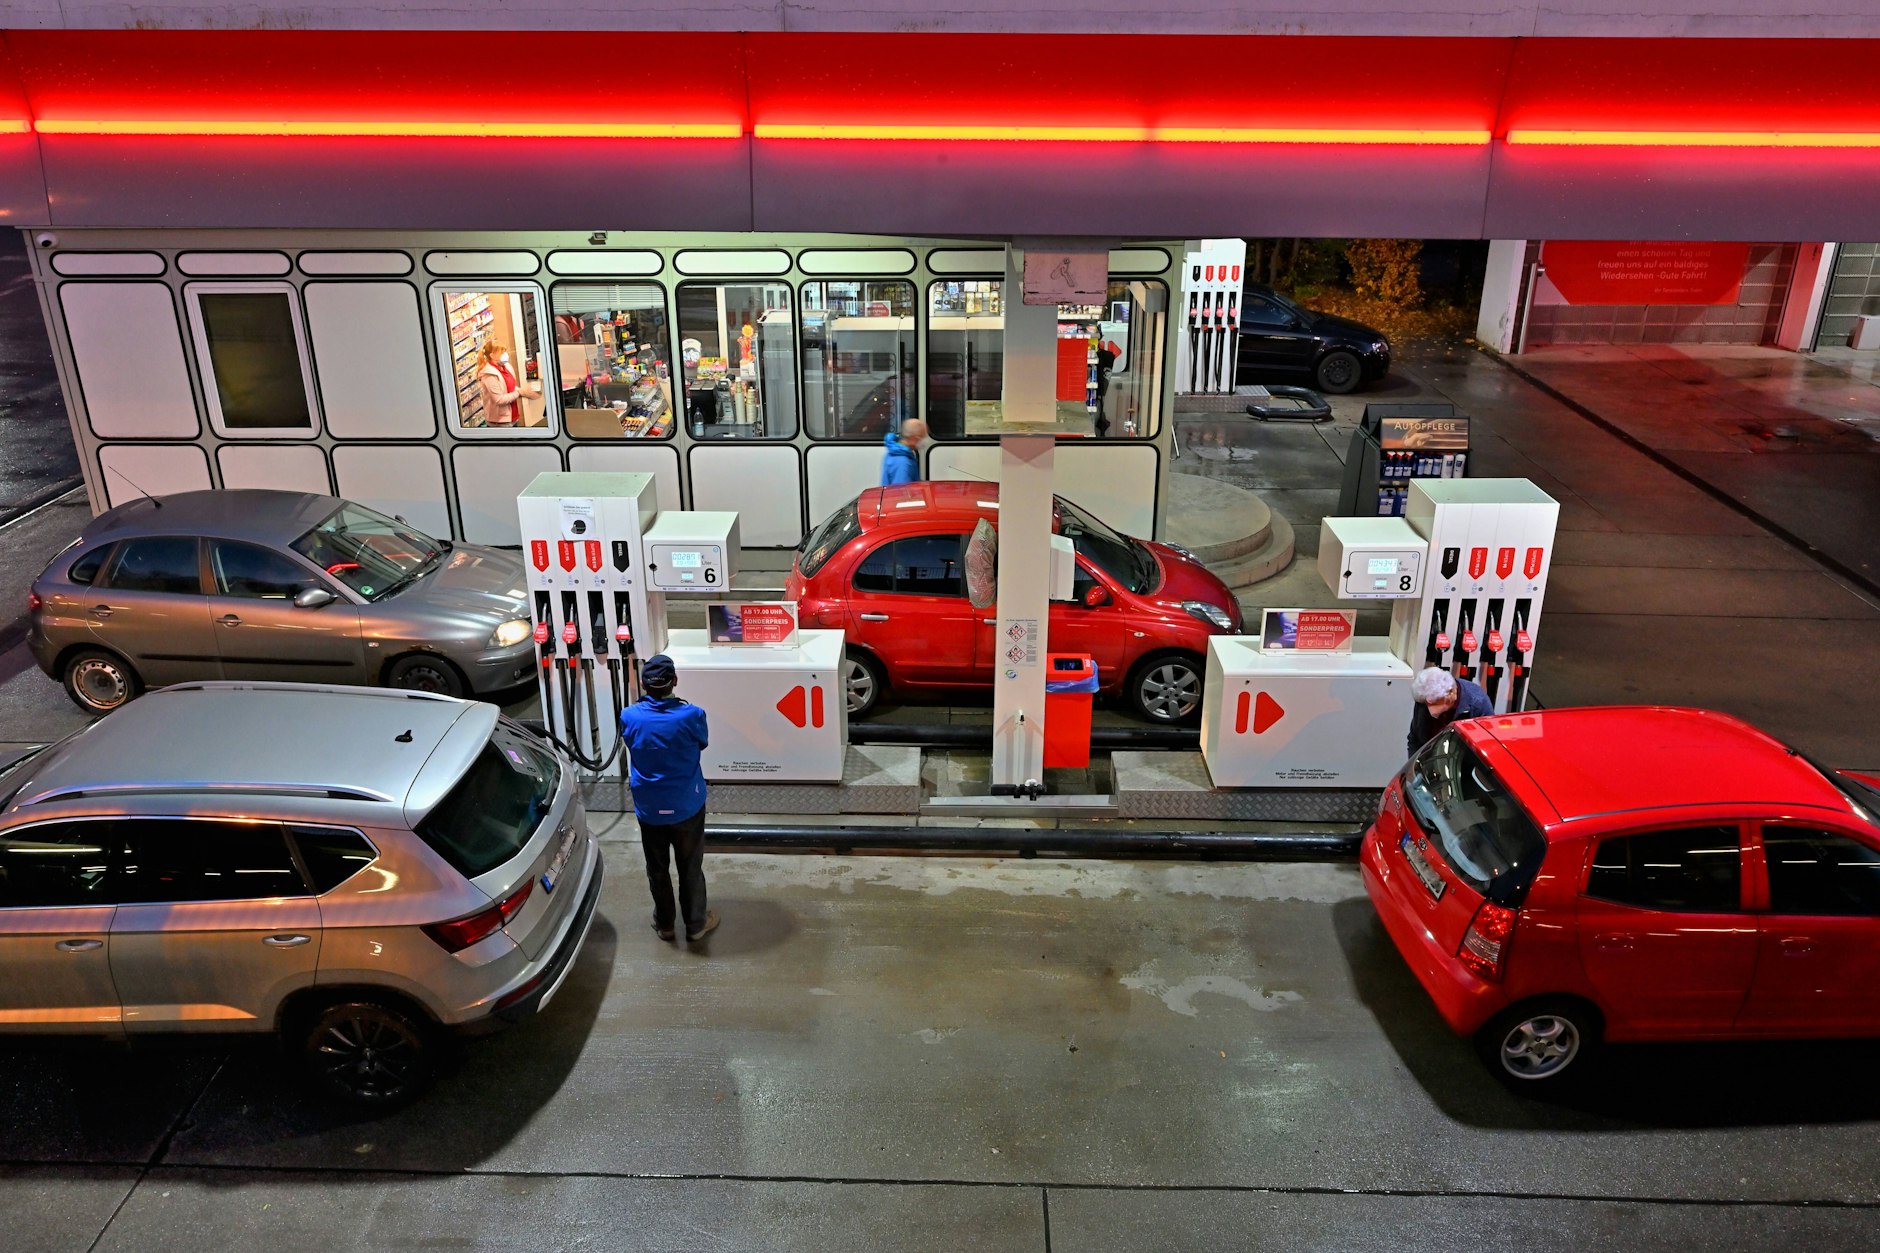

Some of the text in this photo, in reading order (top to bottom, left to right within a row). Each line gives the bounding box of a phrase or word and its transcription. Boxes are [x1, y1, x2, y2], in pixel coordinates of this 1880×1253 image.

[1679, 249, 1693, 258] Tag
[1598, 260, 1624, 268] freuen
[1644, 260, 1658, 268] auf
[1674, 260, 1709, 270] baldiges
[1600, 271, 1654, 280] Wiedersehen
[1681, 271, 1707, 280] Fahrt!
[1394, 422, 1456, 431] AUTOPFLEGE
[704, 568, 716, 583] 6
[1399, 575, 1412, 591] 8
